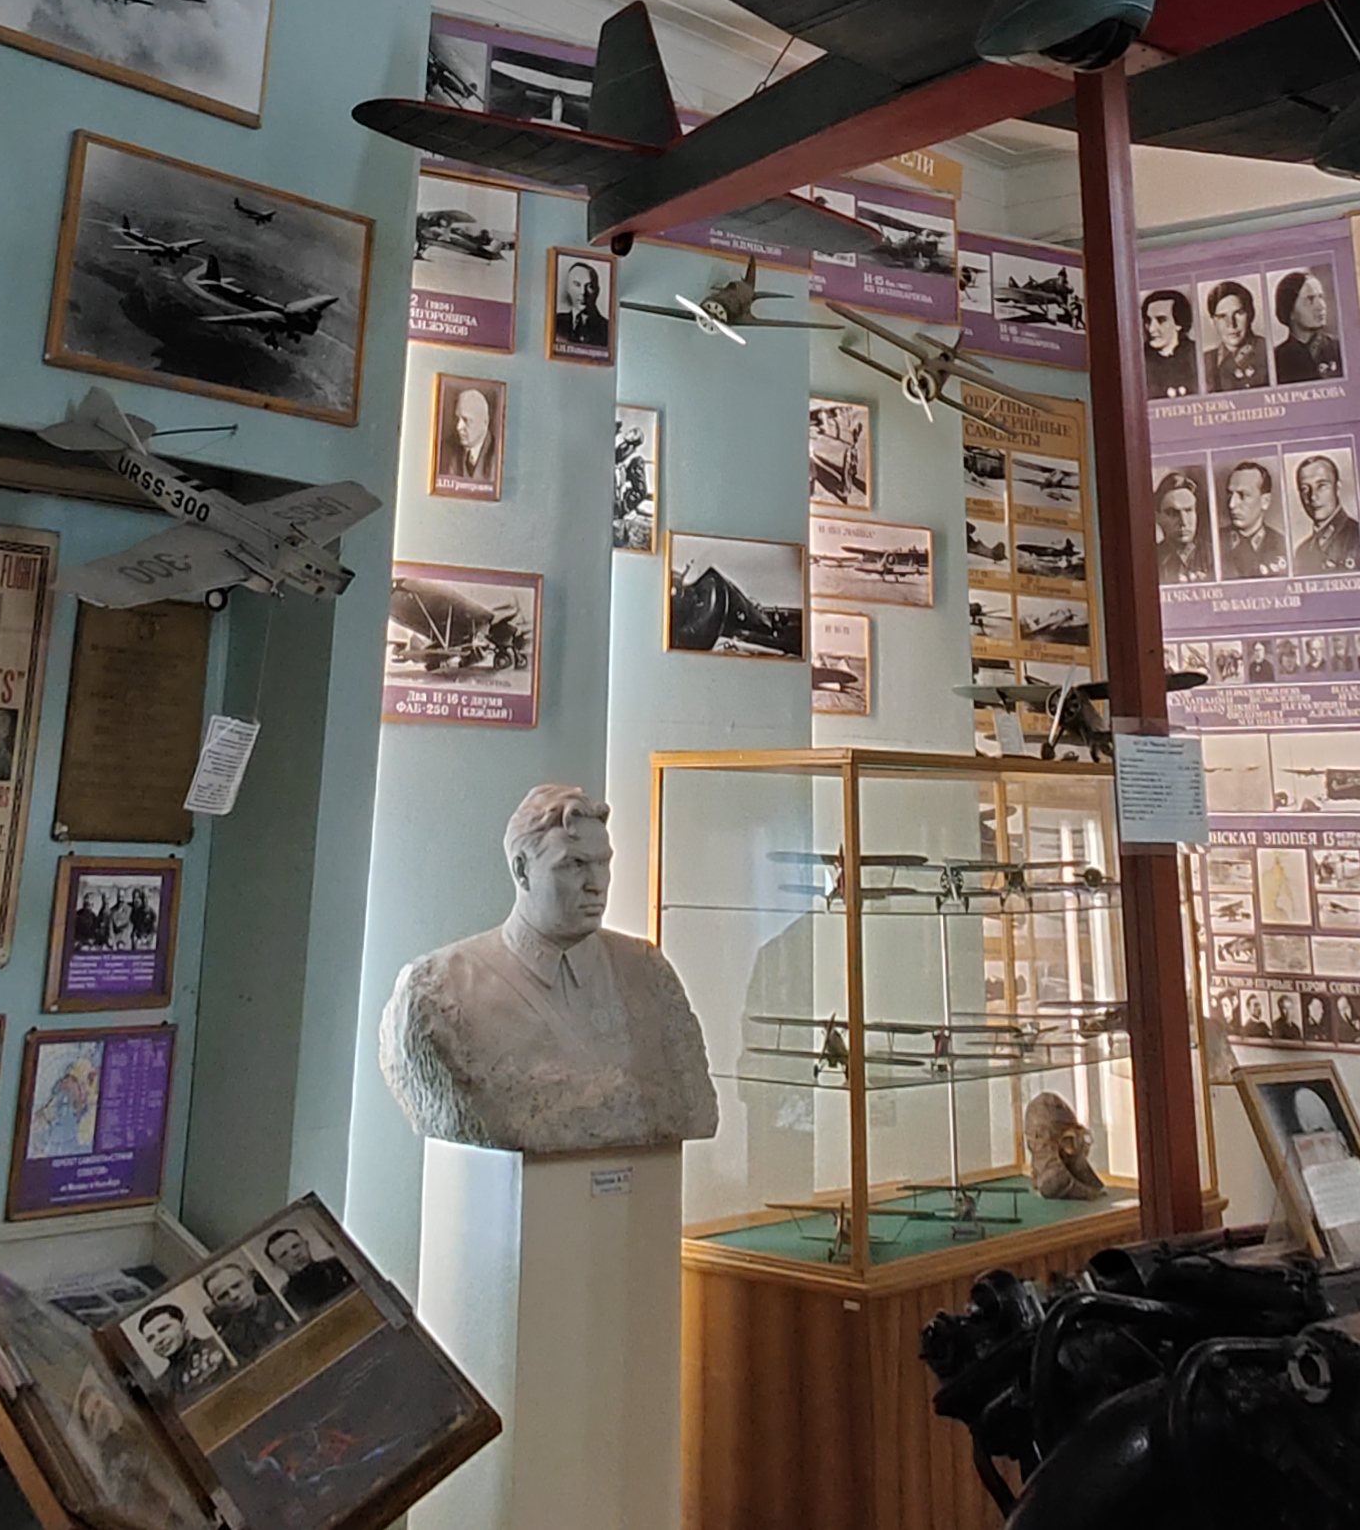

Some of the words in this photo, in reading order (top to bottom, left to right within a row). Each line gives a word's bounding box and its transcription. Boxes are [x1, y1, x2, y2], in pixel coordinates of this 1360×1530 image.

[117, 456, 211, 522] URSS-300
[0, 554, 39, 591] FLIGHT
[406, 690, 428, 702] Два
[433, 691, 459, 704] И-16
[461, 695, 468, 704] с
[470, 696, 504, 709] двумя
[395, 700, 450, 716] ФАБ-250
[457, 706, 514, 722] (каждый)
[1263, 831, 1318, 846] ЭПОПЕЯ
